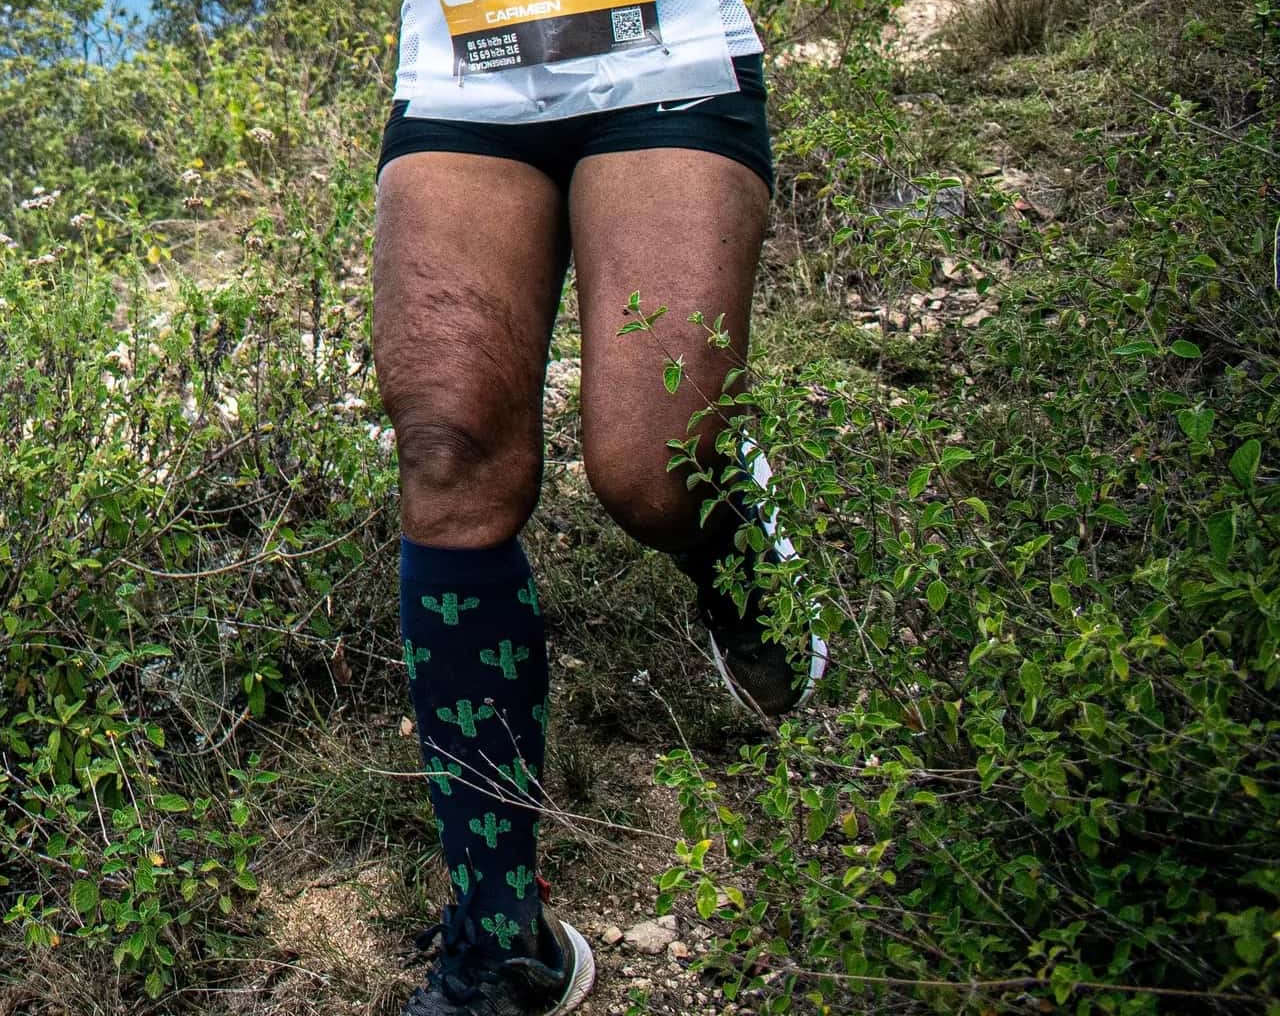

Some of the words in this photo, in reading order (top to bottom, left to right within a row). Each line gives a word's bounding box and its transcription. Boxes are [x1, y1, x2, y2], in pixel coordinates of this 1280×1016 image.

[485, 0, 561, 23] CARMEN
[502, 32, 518, 44] 312
[505, 44, 520, 55] 312
